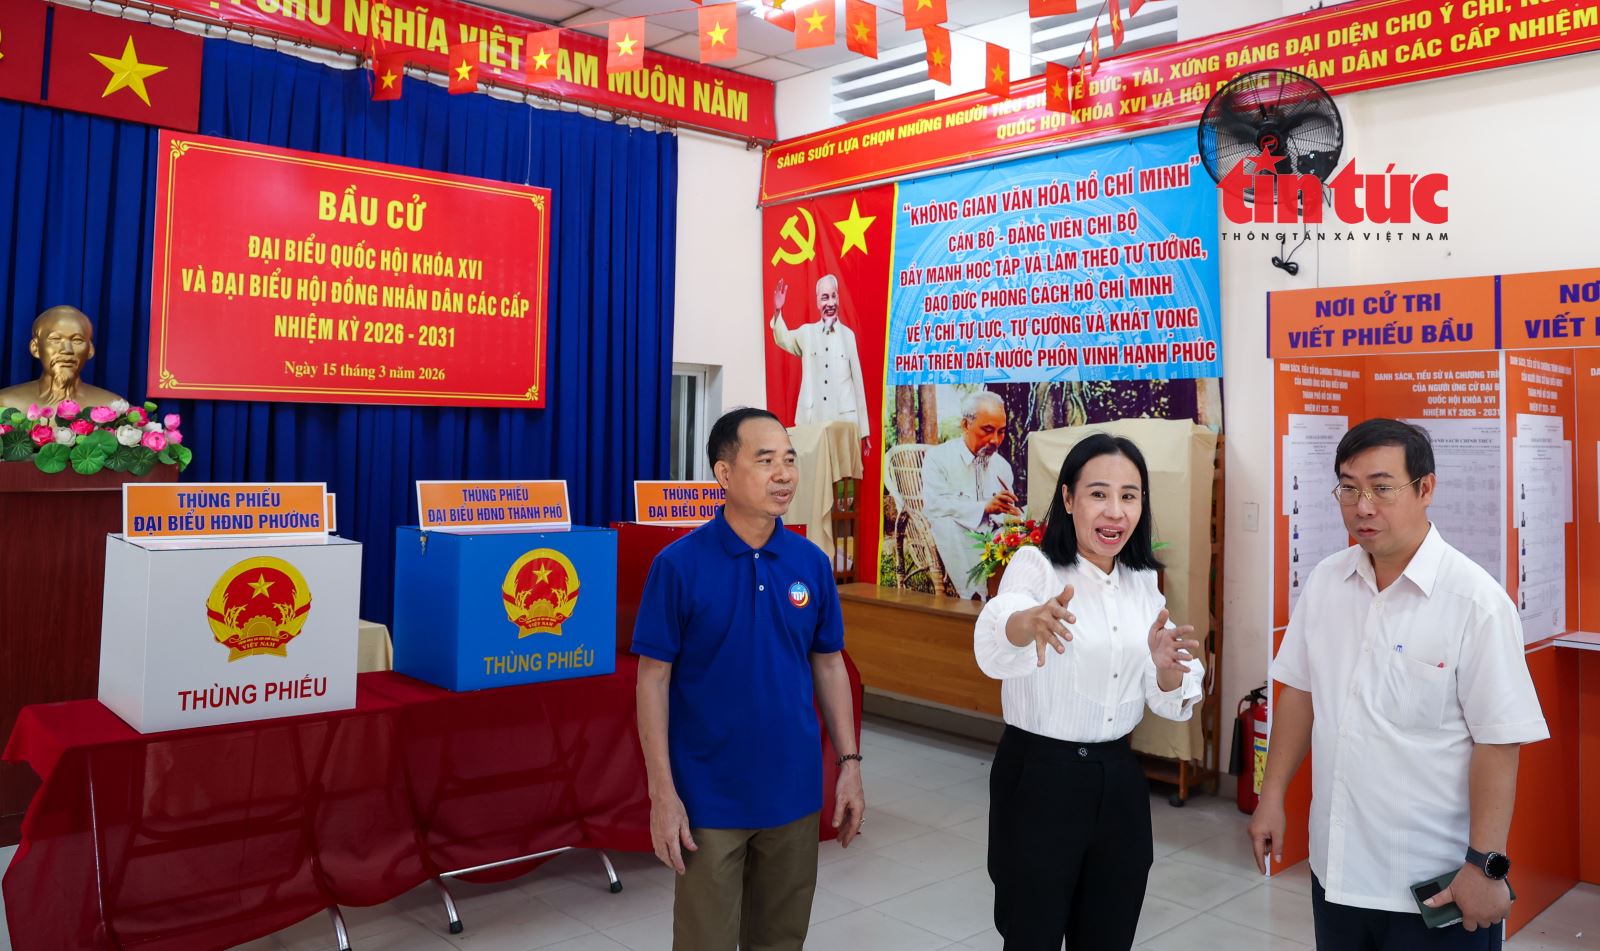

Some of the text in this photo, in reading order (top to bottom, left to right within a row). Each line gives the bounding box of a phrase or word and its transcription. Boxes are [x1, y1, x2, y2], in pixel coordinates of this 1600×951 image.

[344, 0, 449, 55] NGHĨA
[556, 47, 598, 88] AM
[608, 64, 685, 108] MUÔN
[693, 78, 748, 122] NĂM
[996, 115, 1036, 140] QUỐC
[1041, 112, 1066, 133] HỘI
[1070, 103, 1114, 125] KHÓA
[1119, 95, 1147, 116] XVI
[1151, 88, 1175, 108] VÀ
[1179, 82, 1210, 103] HỘI
[1341, 49, 1388, 74] DÂN
[1395, 38, 1442, 64] CÁC
[1450, 22, 1500, 53] CẤP
[1509, 6, 1598, 42] NHIỆM
[777, 1, 1454, 169] SÁNG SUỐT LỰA CHỌN NHỮNG NGƯỜI ĐỨC, TÀI, XỨNG ĐÁNG ĐẠI DIỆN CHO Ý
[318, 184, 427, 232] BẦU CỬ
[962, 195, 997, 218] GIAN
[1002, 187, 1033, 212] VĂN
[1038, 180, 1071, 206] HÓA
[1076, 172, 1098, 200] HỒ
[1104, 167, 1133, 197] CHÍ
[948, 208, 1138, 253] CÁN BỘ ĐẢNG VIÊN CHI BỘ
[248, 233, 483, 280] ĐẠI BIỂU QUỐC HỘI KHÓA XVI
[900, 234, 1207, 286] ĐẨY MẠNH HỌC TẬP VÀ LÀM THEO TƯ TƯỞNG,
[181, 264, 530, 318] VÀ ĐẠI BIỂU HỘI ĐỒNG NHÂN DÂN CÁC CẤP
[924, 295, 948, 315] ĐẠO
[952, 291, 977, 310] ĐỨC
[981, 288, 1027, 308] PHONG
[1031, 283, 1069, 305] CÁCH
[1099, 276, 1124, 299] CHÍ
[1129, 276, 1172, 297] MINH
[1315, 290, 1441, 317] NƠI CỬ TRI
[274, 312, 455, 347] NHIỆM KỲ 2026 2031
[907, 307, 1198, 342] VỀ Ý CHÍ TỰ LỰC, TỰ CƯỜNG VÀ KHÁT VỌNG
[1288, 317, 1473, 348] VIẾT PHIẾU BẦU
[1524, 311, 1585, 339] VIẾT
[284, 360, 446, 380] Ngày 15 tháng 3 năm 2026
[896, 338, 1216, 371] PHÁT TRIỂN ĐẤT NƯỚC PHỒN VINH HẠNH PHÚC
[177, 487, 281, 509] THÙNG PHIẾU
[462, 484, 529, 502] THÙNG PHIẾU
[648, 501, 696, 520] ĐẠI BIỂU
[662, 486, 699, 500] THÙNG
[134, 508, 320, 536] ĐẠI BIỂU HĐND PHƯỜNG
[428, 502, 563, 526] ĐẠI BIỂU HĐND THÀNH PHỐ
[483, 643, 595, 675] THÙNG PHIẾU
[178, 673, 327, 712] THÙNG PHIẾU
